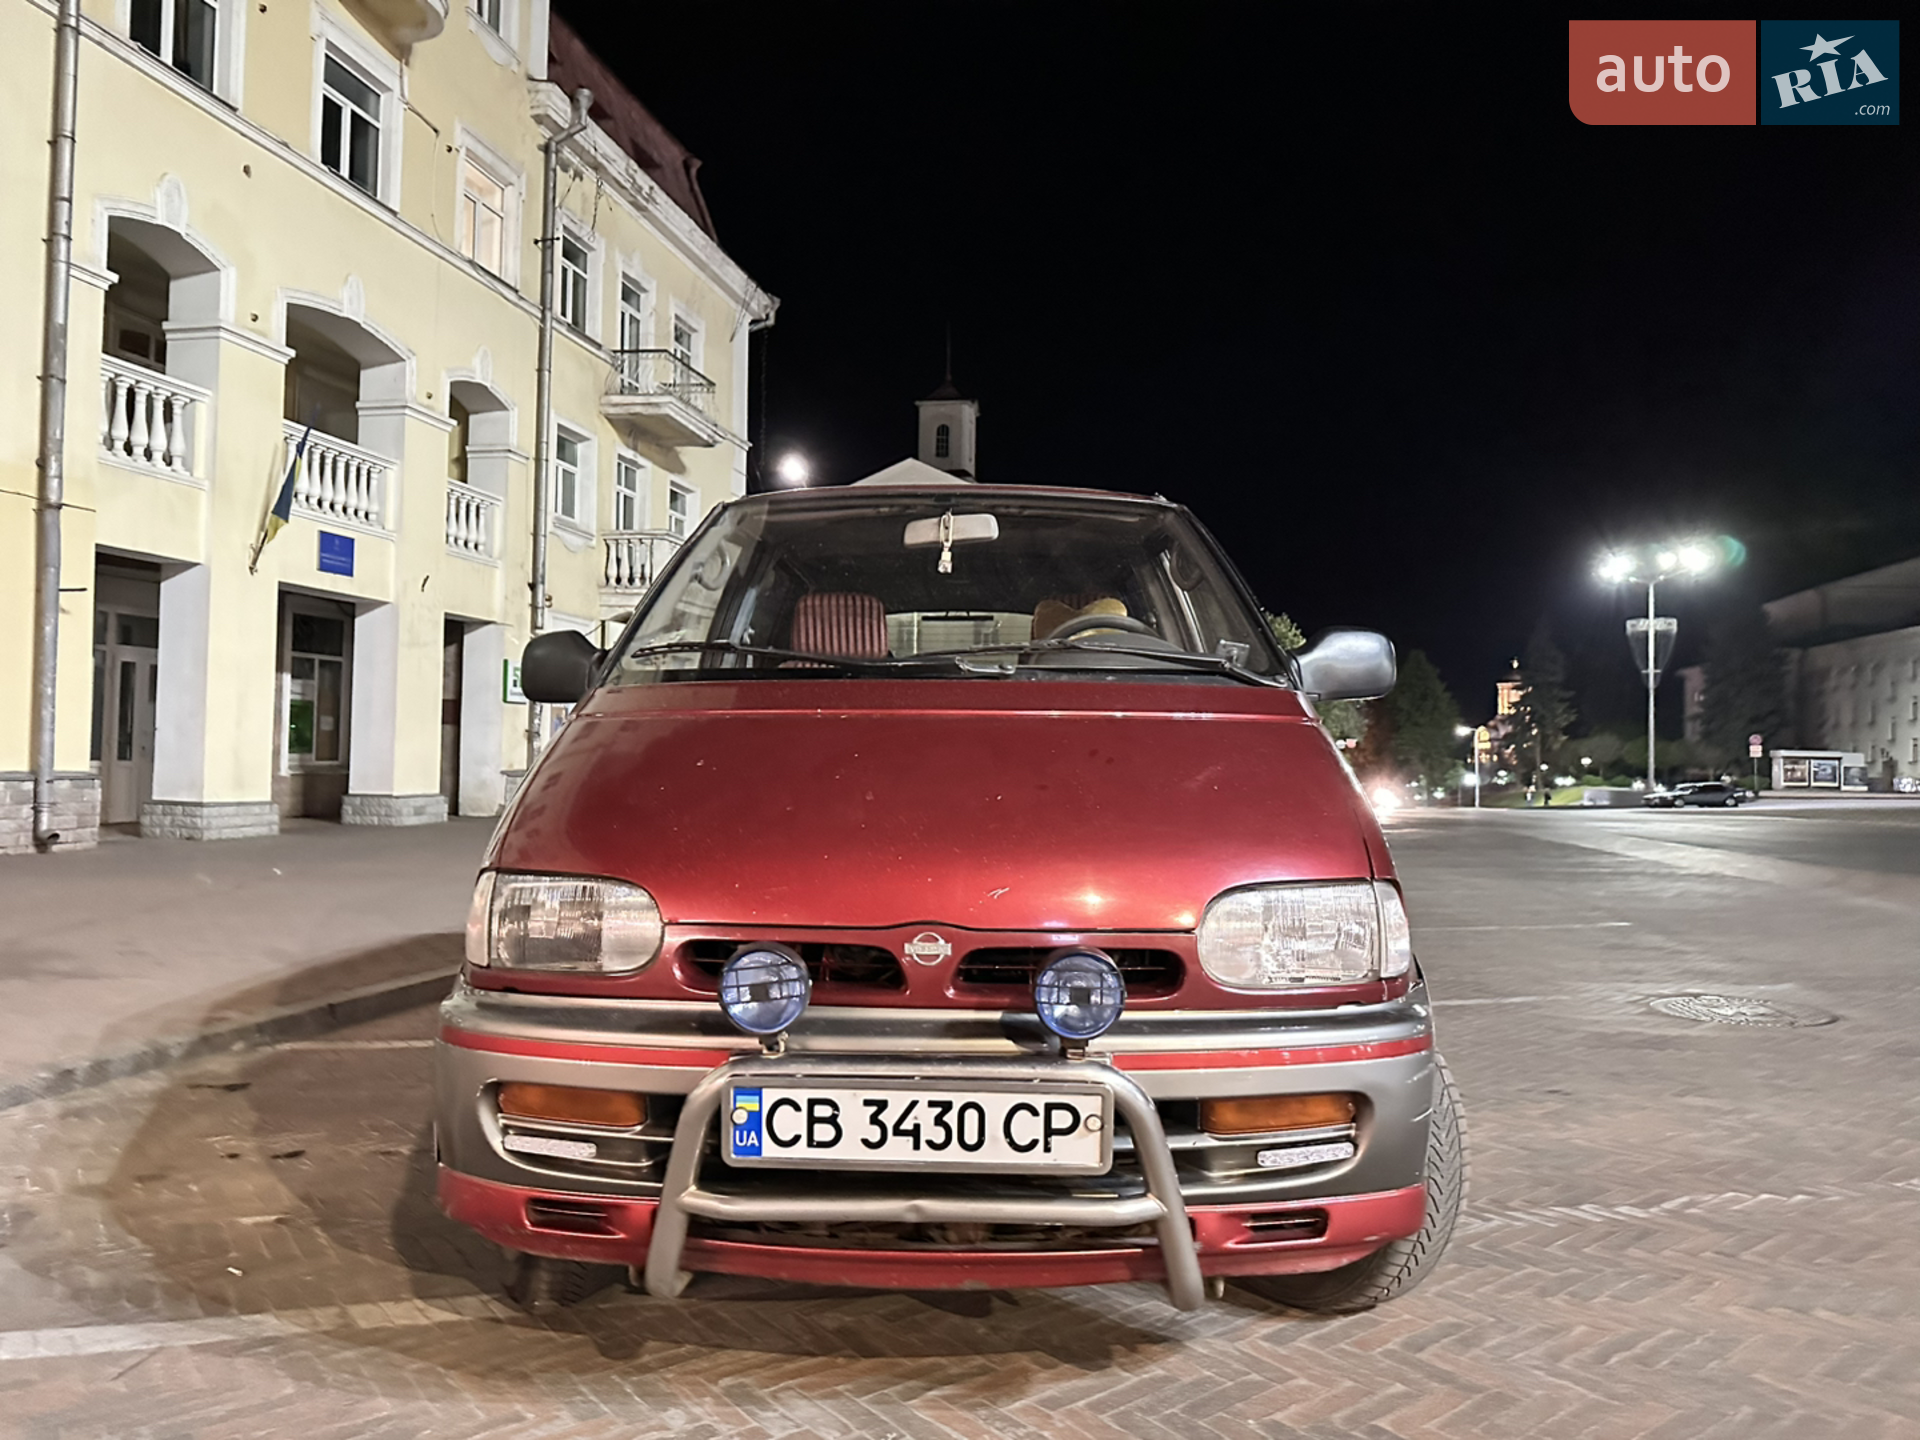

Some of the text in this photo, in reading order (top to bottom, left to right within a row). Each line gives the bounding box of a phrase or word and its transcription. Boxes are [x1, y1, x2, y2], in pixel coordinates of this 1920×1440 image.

[735, 1130, 759, 1147] UA
[765, 1097, 1081, 1153] CB 3430 CP
